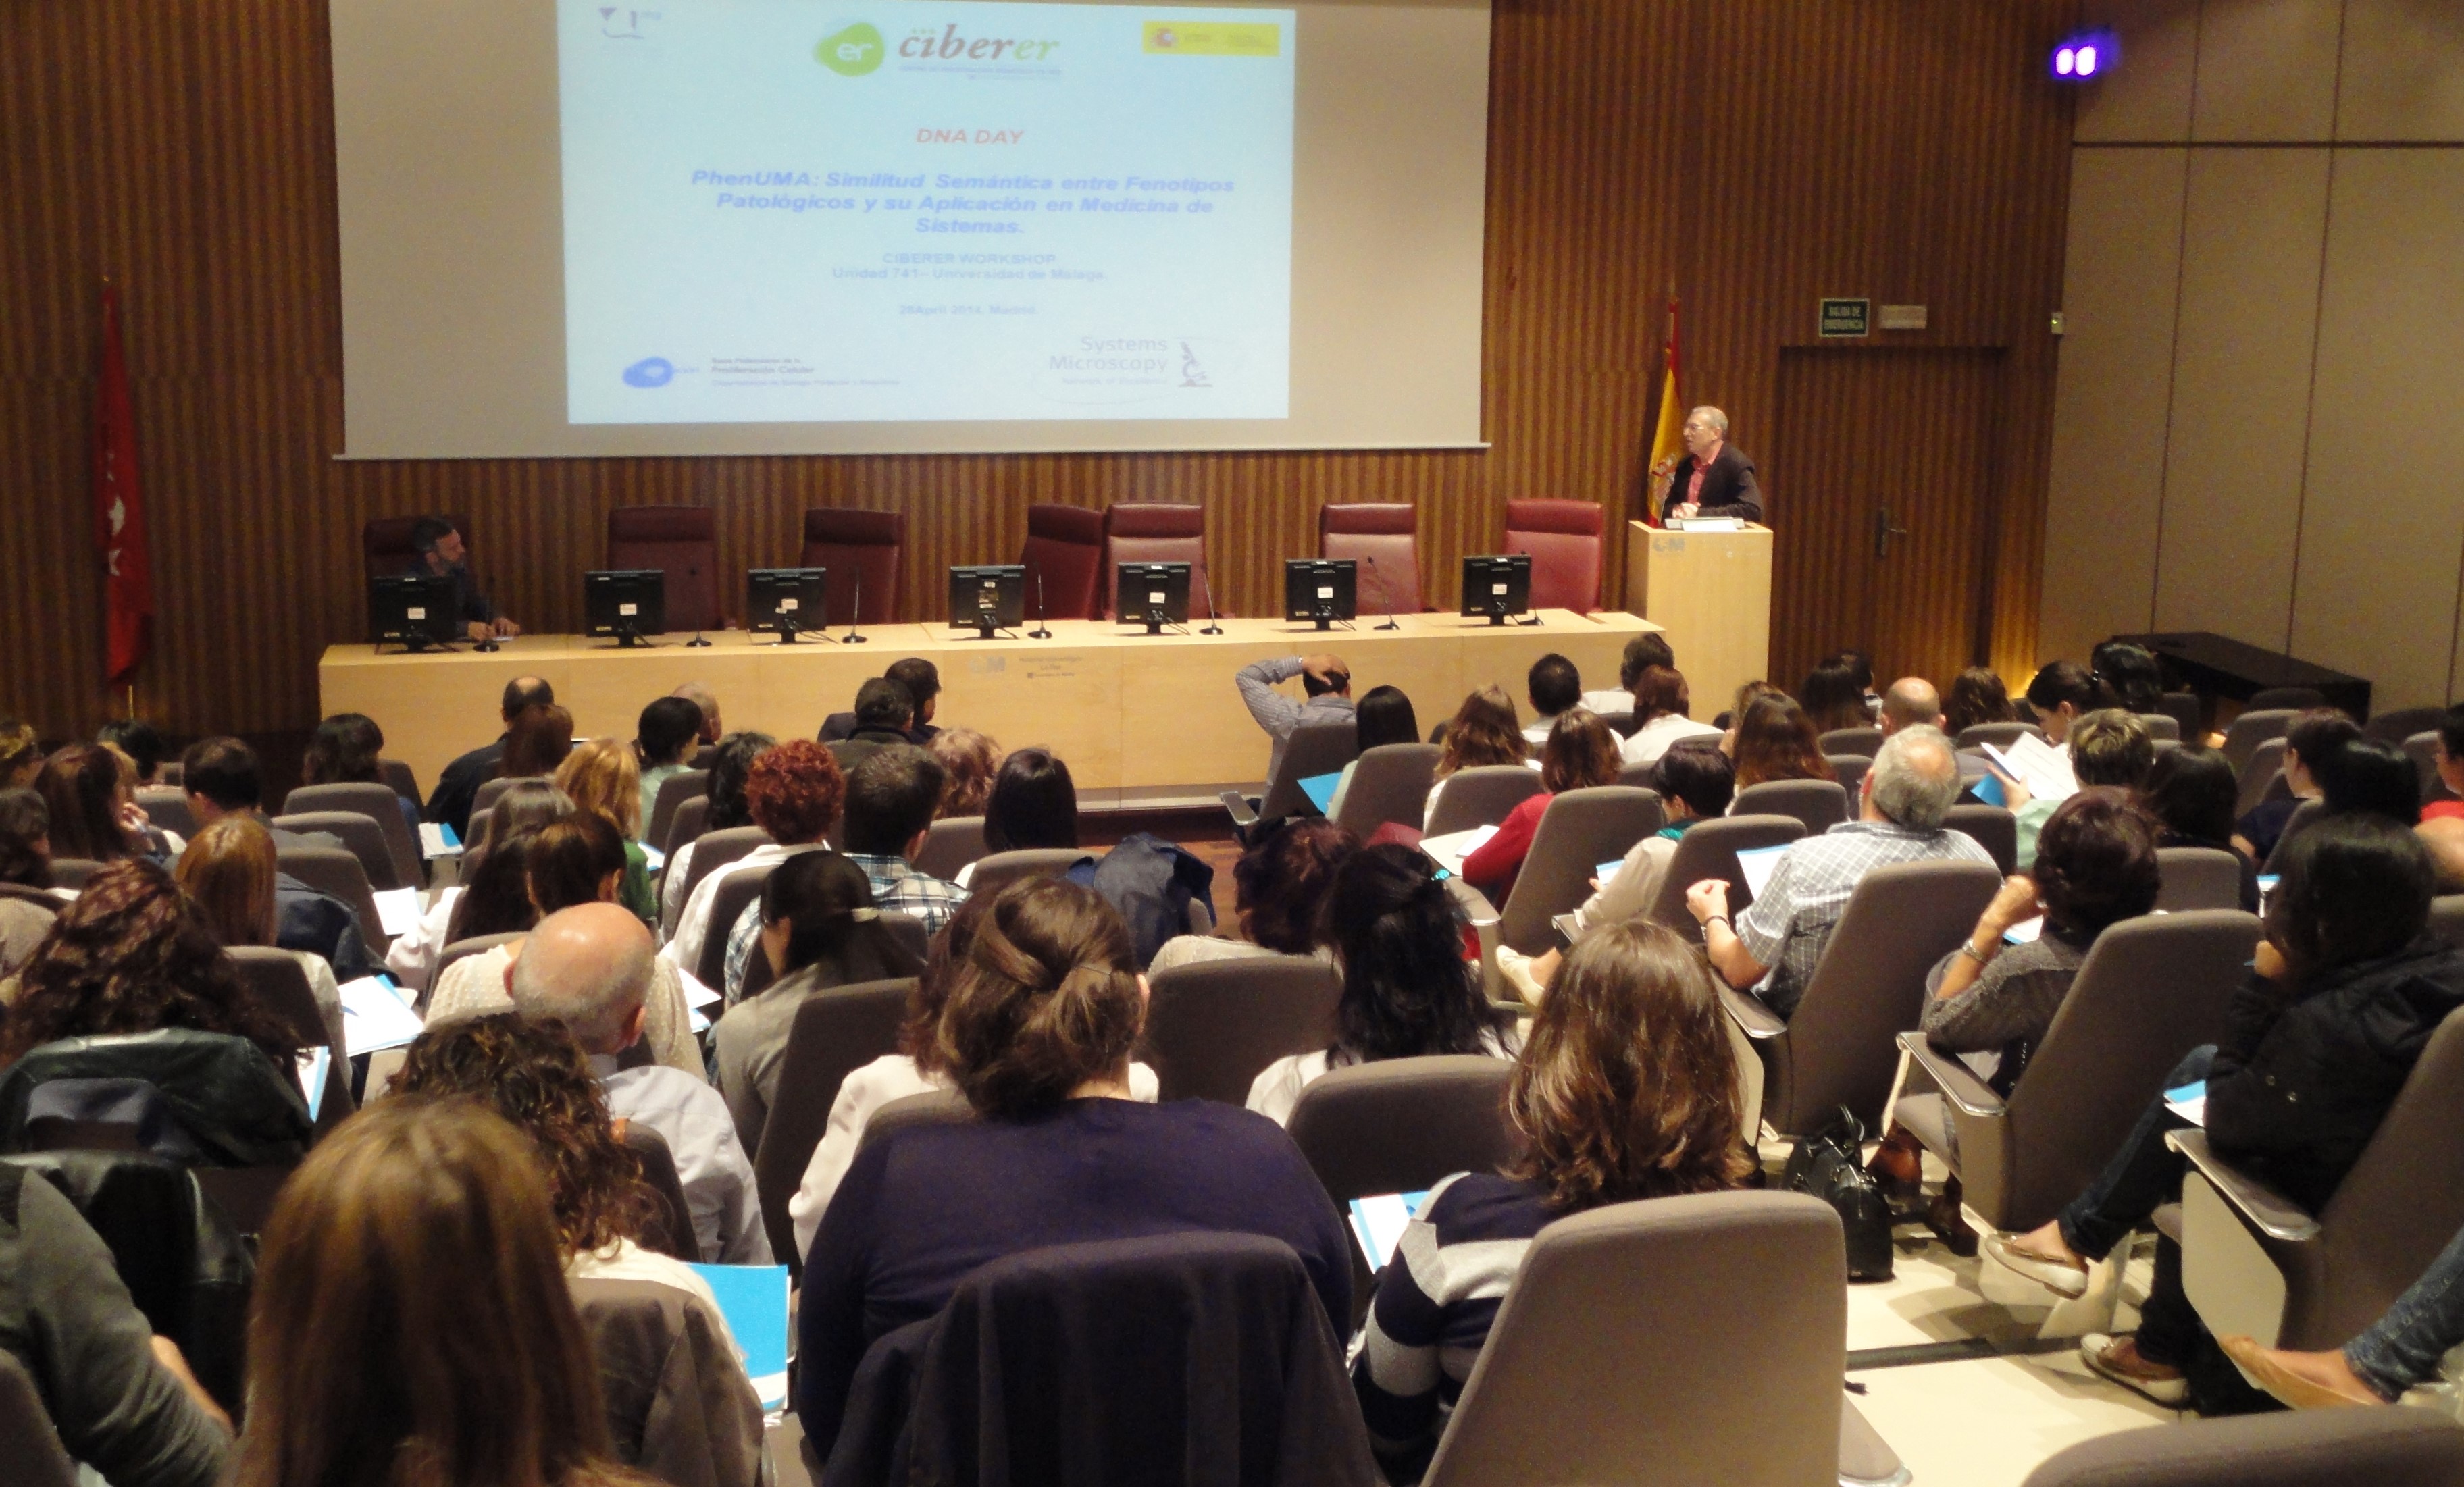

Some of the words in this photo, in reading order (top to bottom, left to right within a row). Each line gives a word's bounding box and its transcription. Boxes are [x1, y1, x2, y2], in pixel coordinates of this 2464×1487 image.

[836, 43, 875, 62] er
[915, 128, 968, 144] DNA
[974, 129, 1025, 145] DAY
[691, 169, 820, 187] PhenUMA:
[825, 172, 925, 188] Similitud
[934, 173, 1053, 190] Semántica
[1061, 176, 1118, 192] entre
[1125, 176, 1235, 194] Fenotipos
[716, 193, 855, 213] Patológicos
[863, 196, 879, 213] y
[883, 197, 912, 211] su
[917, 195, 1037, 213] Aplicación
[1045, 199, 1073, 212] en
[1081, 197, 1179, 213] Medicina
[1186, 199, 1214, 213] de
[915, 217, 1025, 234] Sistemas.
[881, 253, 956, 264] CIBERER
[959, 253, 1056, 264] WORKSHOP
[831, 267, 888, 279] Unidad
[933, 268, 1025, 279] Universidad
[1080, 336, 1169, 354] Systems
[1049, 355, 1169, 372] Microscopy
